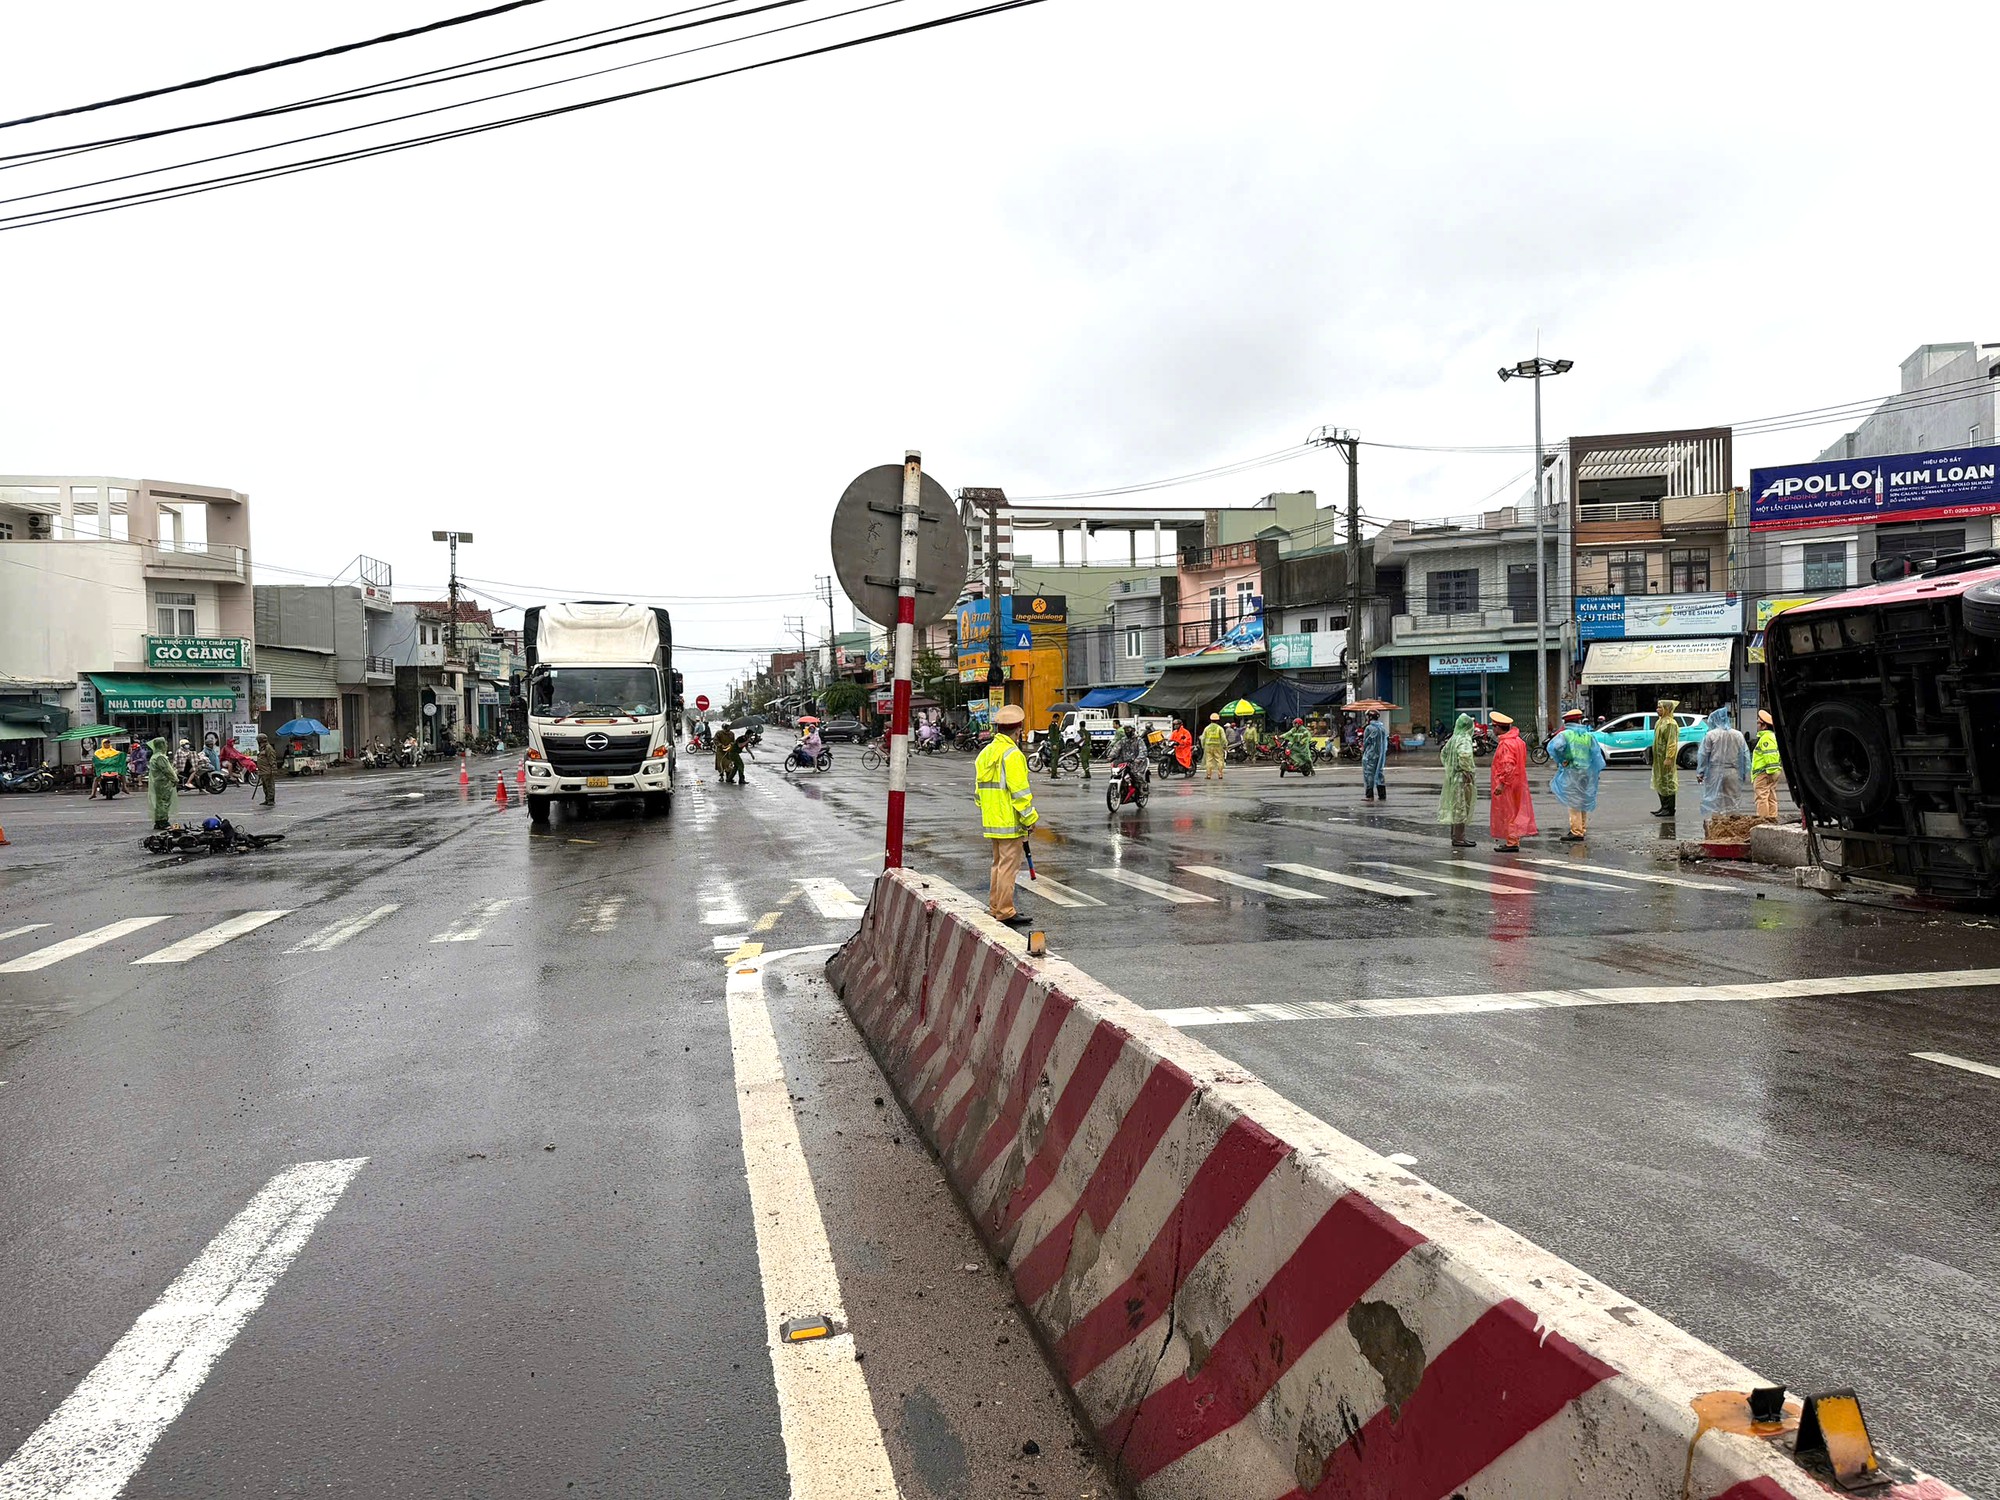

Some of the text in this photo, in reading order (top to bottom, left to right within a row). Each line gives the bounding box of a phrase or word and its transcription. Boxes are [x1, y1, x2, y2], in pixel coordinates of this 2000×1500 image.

[1890, 464, 1994, 486] KIM LOAN
[1756, 470, 1872, 503] APOLLO
[156, 644, 182, 659] GÒ
[186, 646, 235, 659] GĂNG
[1440, 655, 1498, 664] ĐÀO NGUYÊN
[109, 698, 129, 708] NHÀ
[132, 697, 164, 708] THUỐC
[166, 696, 187, 709] GÒ
